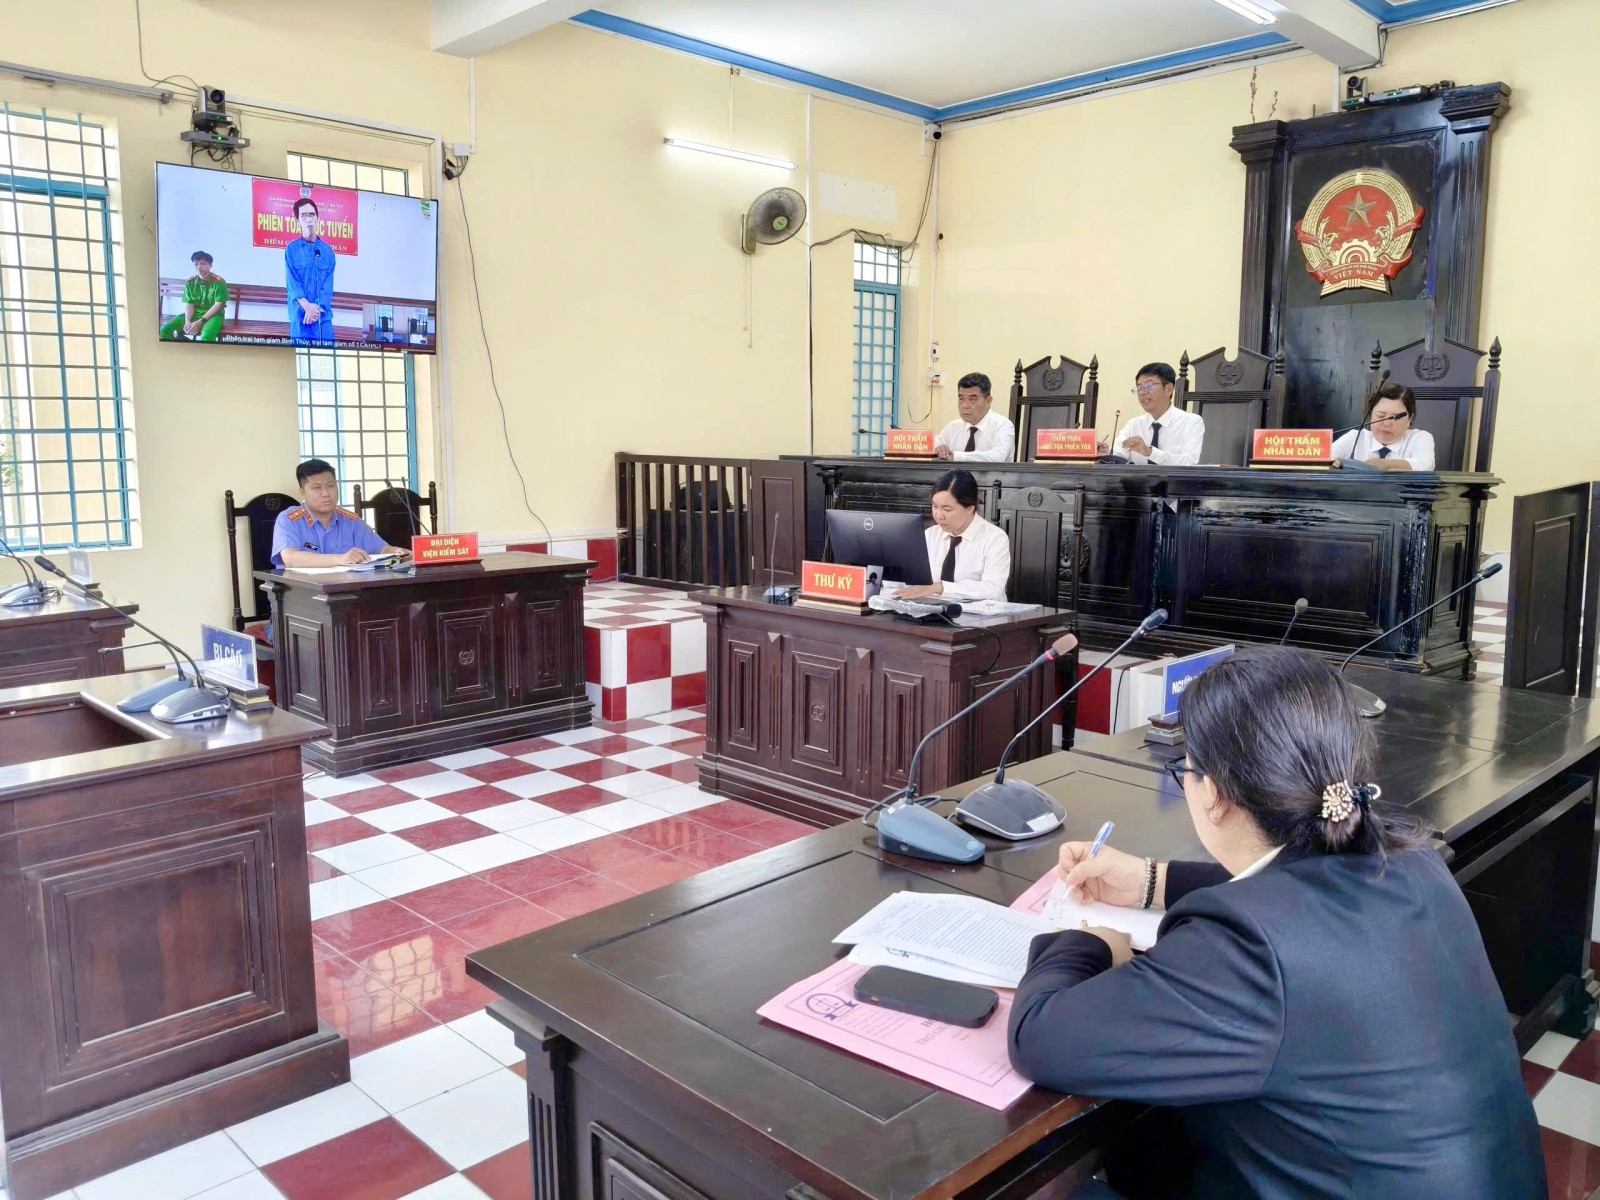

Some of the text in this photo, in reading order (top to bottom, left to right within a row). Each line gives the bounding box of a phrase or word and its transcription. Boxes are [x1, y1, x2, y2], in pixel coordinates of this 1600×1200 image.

[258, 210, 283, 232] PHIÊN
[327, 216, 354, 238] TUYẾN
[1334, 270, 1352, 279] VIỆT
[894, 433, 928, 442] HỘI THẨM
[1265, 433, 1320, 446] HỘI THẨM
[1263, 446, 1320, 456] NHÂN DÂN
[444, 537, 459, 546] DIỆN
[423, 546, 469, 558] VIỆN KIỂM SÁT
[814, 573, 853, 590] THƯ KÝ
[225, 643, 243, 669] CÁO
